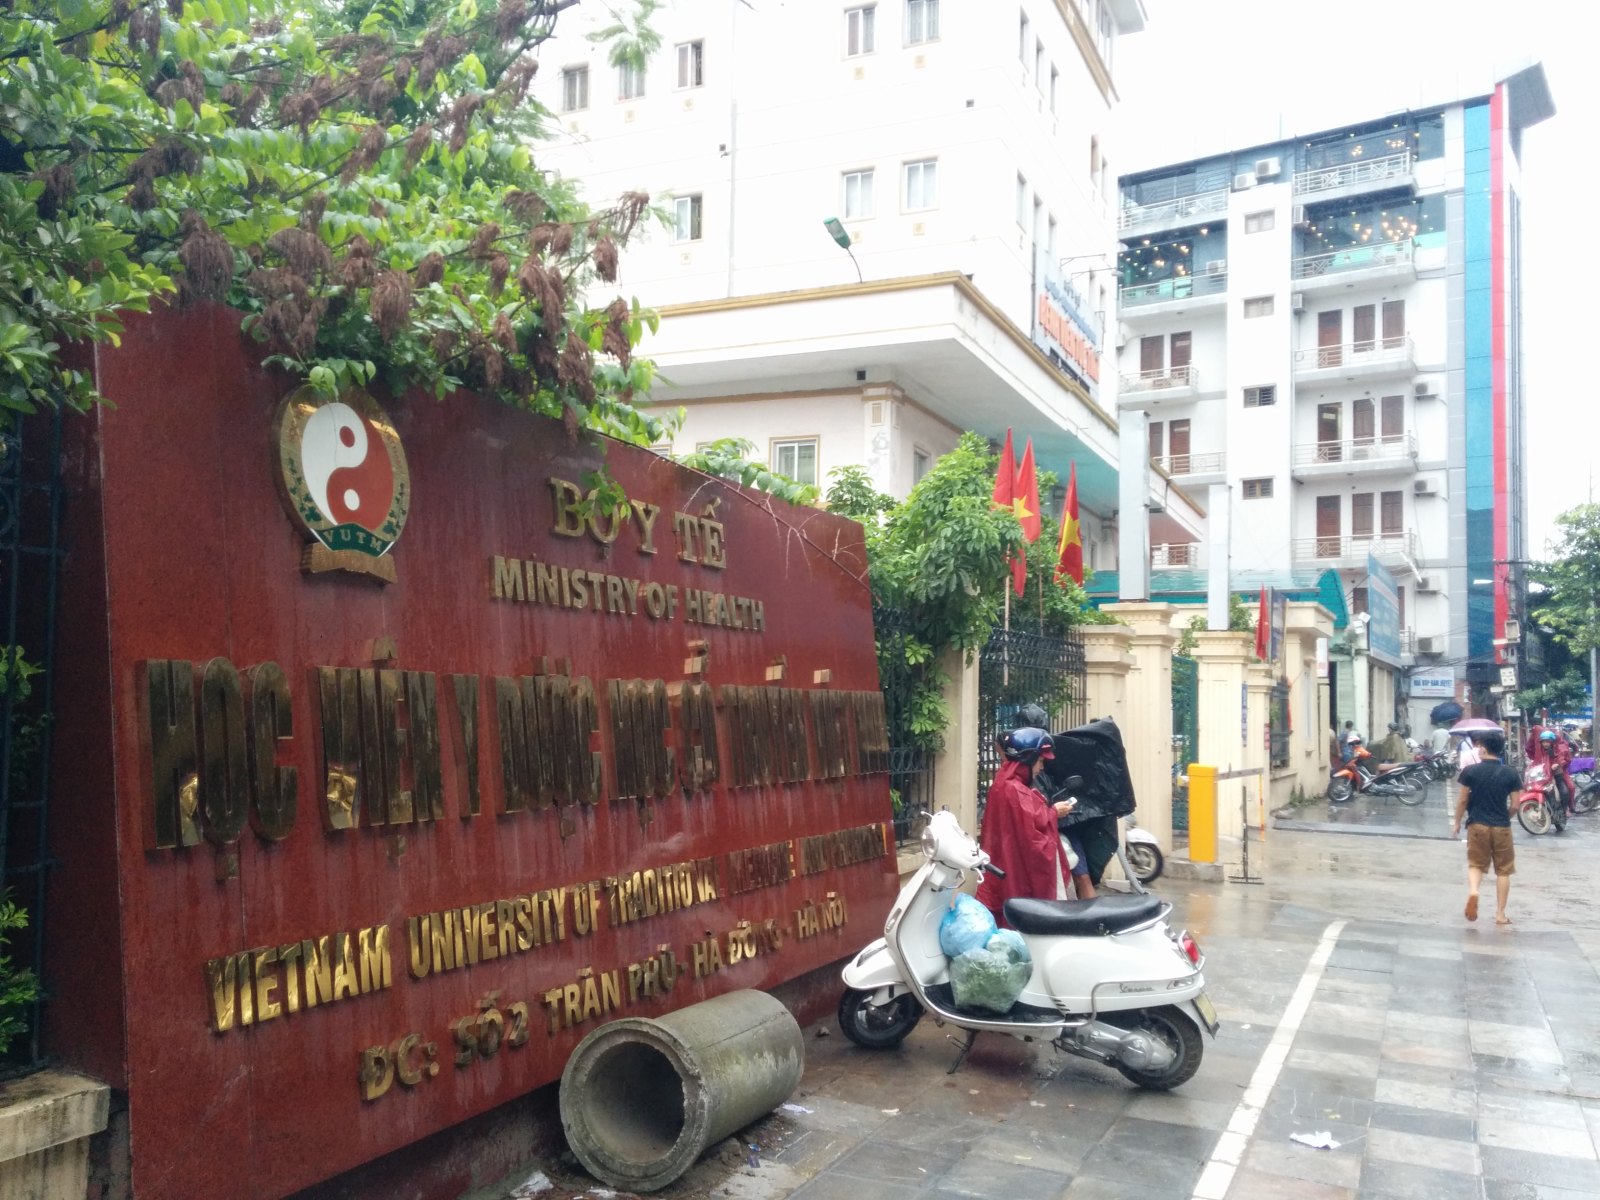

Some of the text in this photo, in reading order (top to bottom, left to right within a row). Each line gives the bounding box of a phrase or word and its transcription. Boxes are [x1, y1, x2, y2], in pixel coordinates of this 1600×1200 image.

[323, 529, 382, 552] VUTM
[631, 499, 660, 554] Y
[674, 497, 727, 569] TẾ
[488, 555, 766, 632] MINISTRY OF HEALTH
[146, 657, 298, 879] HỌC
[206, 924, 393, 1033] VIETNAM
[408, 886, 567, 978] UNIVERSITY
[573, 880, 601, 935] OF
